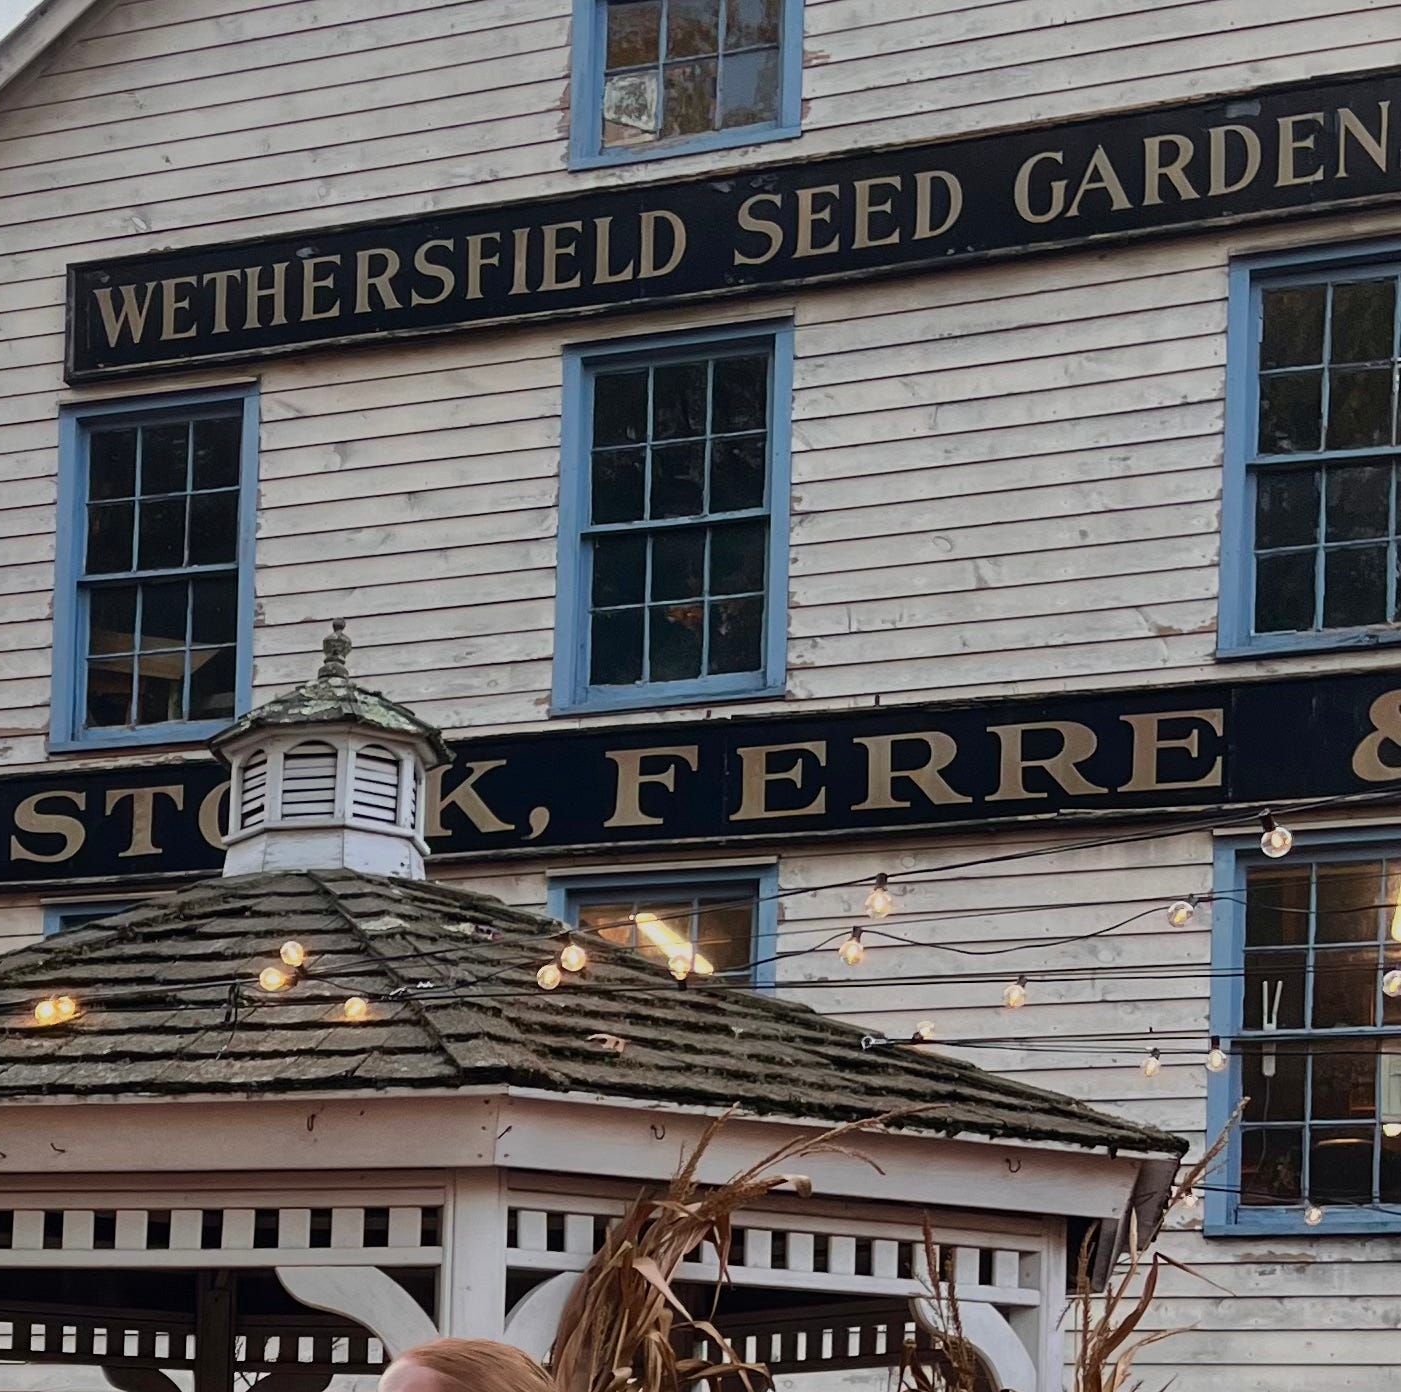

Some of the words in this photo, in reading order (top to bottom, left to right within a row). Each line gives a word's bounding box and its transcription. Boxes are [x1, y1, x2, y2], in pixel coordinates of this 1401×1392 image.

[92, 209, 688, 349] WETHERSFIELD
[733, 169, 964, 267] SEED
[1013, 100, 1401, 225] GARDEN
[602, 706, 1226, 828] FERRE
